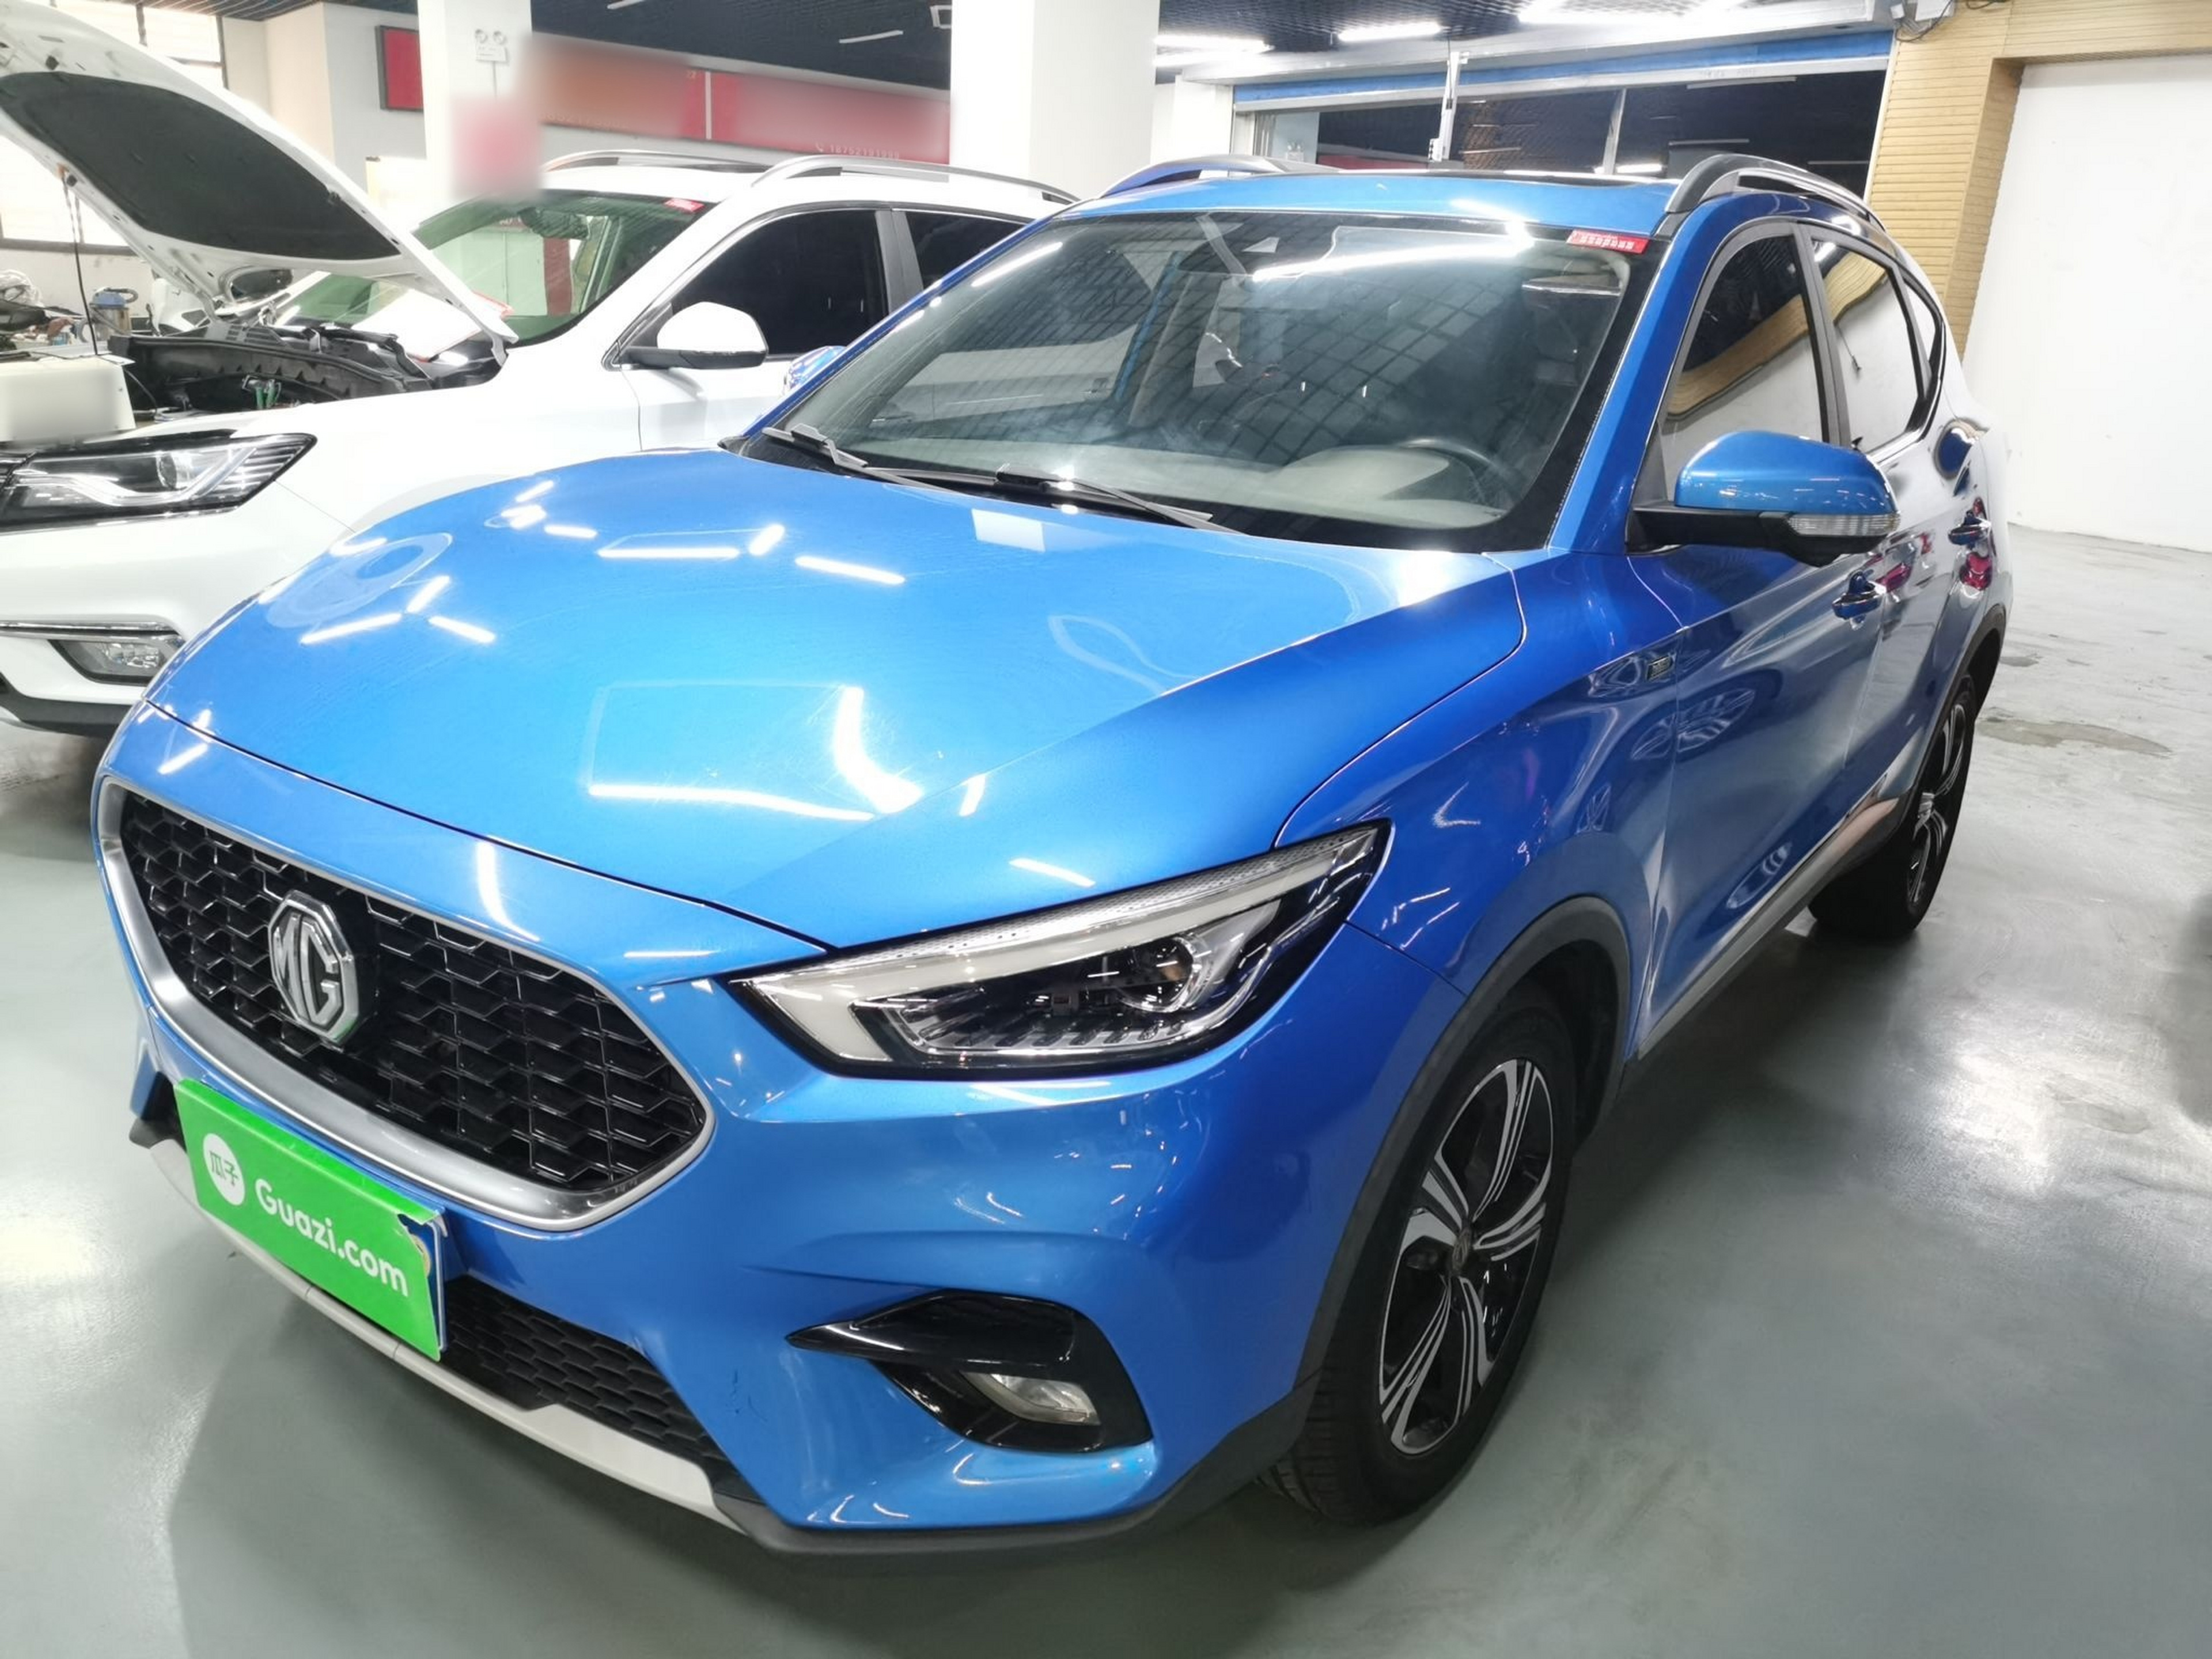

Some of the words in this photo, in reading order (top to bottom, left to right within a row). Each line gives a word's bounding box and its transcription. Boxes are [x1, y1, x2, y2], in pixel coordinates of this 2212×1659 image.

[272, 910, 343, 1027] MG
[209, 1150, 239, 1187] 瓜子
[255, 1179, 408, 1297] Guazi.com
